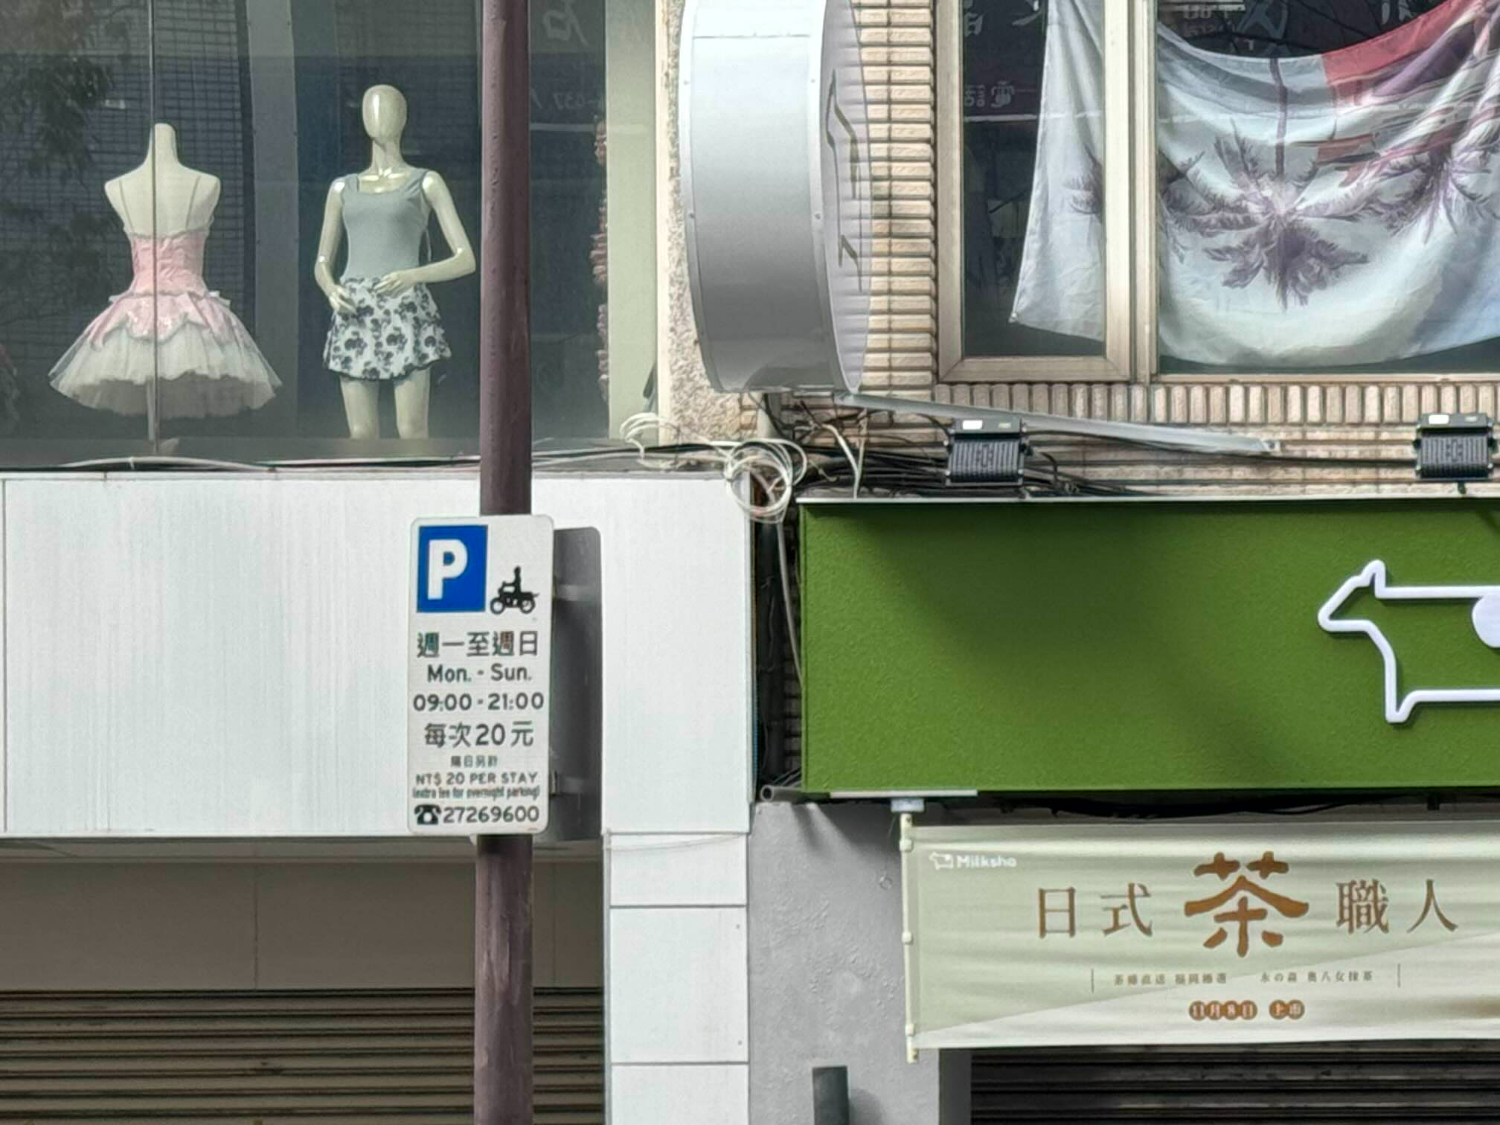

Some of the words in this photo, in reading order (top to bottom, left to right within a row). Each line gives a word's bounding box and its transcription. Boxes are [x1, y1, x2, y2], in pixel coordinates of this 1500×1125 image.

[427, 538, 468, 601] P
[416, 630, 539, 658] 週一至週日
[427, 664, 472, 683] Mon.
[490, 663, 532, 682] Sun.
[412, 693, 472, 712] 09:00
[487, 692, 545, 711] 21:00
[423, 720, 534, 748] 每次20元
[415, 772, 442, 786] NT$
[446, 772, 465, 785] 20
[469, 772, 496, 785] PER
[500, 771, 539, 784] STAY
[452, 786, 465, 799] for
[466, 786, 505, 801] overnight
[442, 805, 540, 824] 27269600
